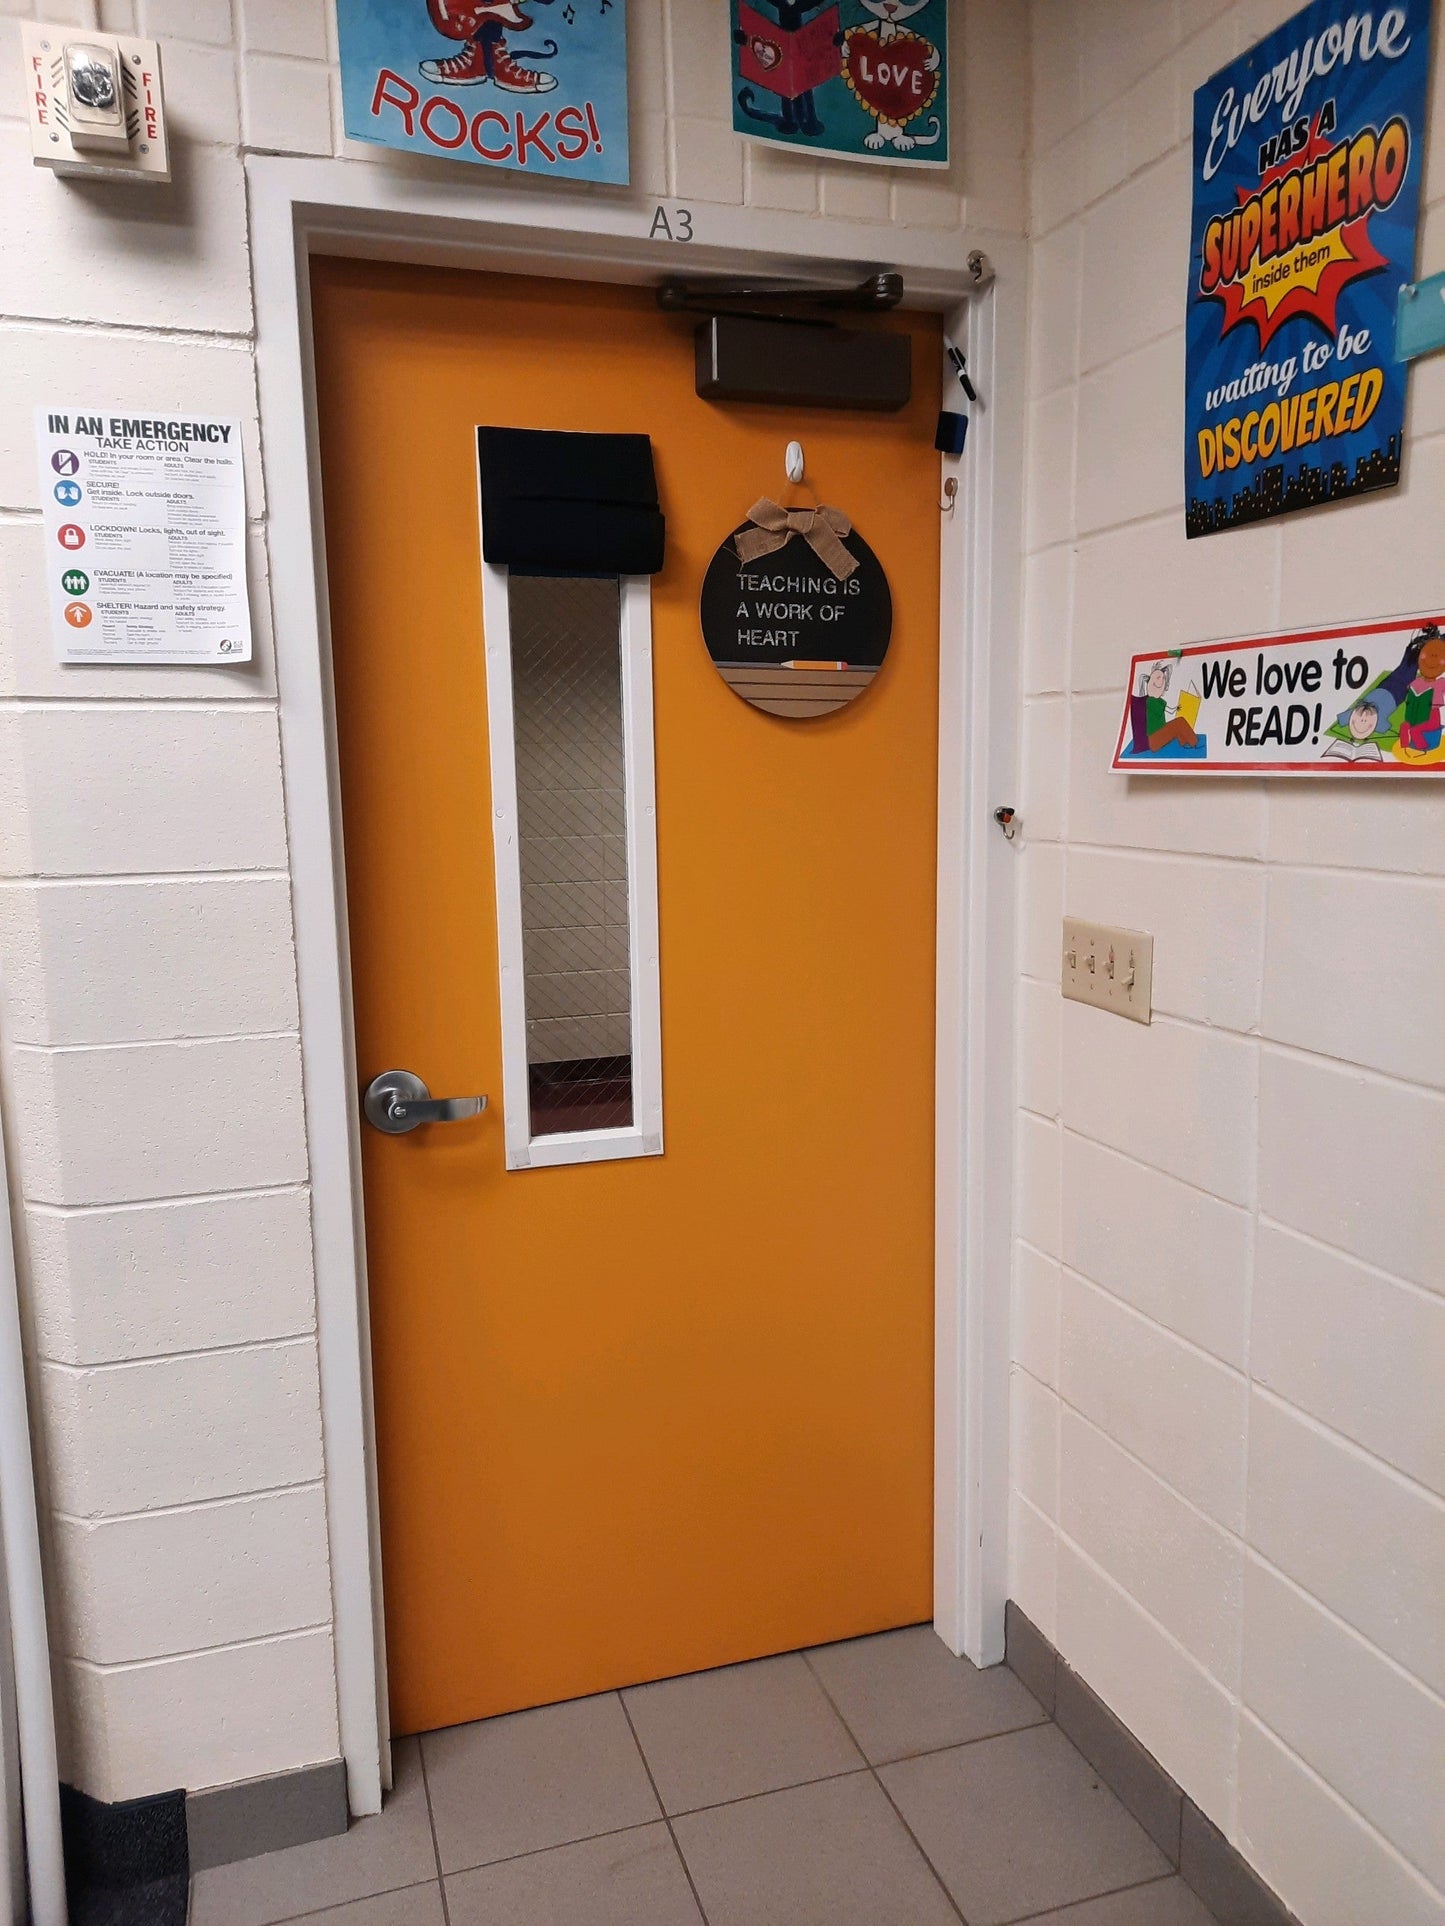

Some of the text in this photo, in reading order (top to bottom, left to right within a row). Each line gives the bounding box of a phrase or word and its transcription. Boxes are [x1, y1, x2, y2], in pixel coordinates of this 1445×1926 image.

[33, 56, 49, 125] FIRE
[859, 55, 923, 94] LOVE
[1203, 9, 1410, 181] Everyone
[142, 72, 158, 139] FIRE
[370, 68, 604, 165] ROCKS!
[1258, 98, 1336, 175] HAS A
[649, 205, 694, 242] A3
[1200, 116, 1410, 294] SUPERHERO
[1252, 245, 1330, 294] inside them
[1205, 323, 1372, 411] waiting to be
[48, 414, 231, 444] IN AN EMERGENCY
[95, 437, 189, 453] TAKE ACTION
[1197, 367, 1384, 479] DISCOVERED
[90, 525, 138, 533] LOCKDOWN!
[139, 526, 162, 534] Locks,
[201, 573, 233, 581] specified)
[736, 573, 861, 596] TEACHING IS
[175, 604, 196, 612] safety
[736, 601, 846, 621] A WORK OF
[737, 629, 800, 647] HEART
[1202, 649, 1369, 700] We love to
[1225, 703, 1322, 747] READ!
